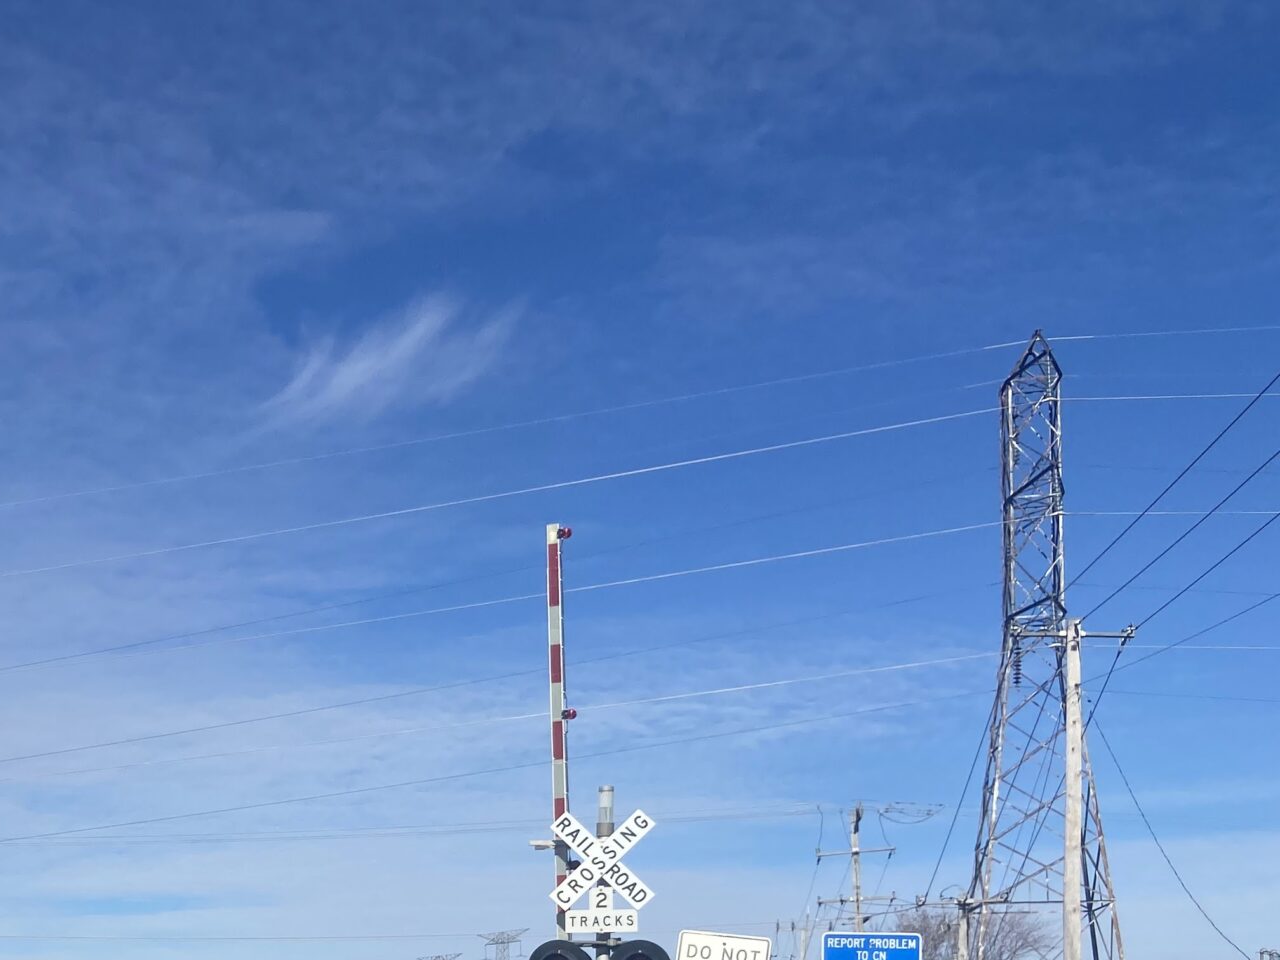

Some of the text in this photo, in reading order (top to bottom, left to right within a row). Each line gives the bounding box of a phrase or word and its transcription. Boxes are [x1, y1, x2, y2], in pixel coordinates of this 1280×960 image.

[556, 815, 649, 904] CROSSING
[595, 892, 608, 908] 2
[569, 915, 634, 927] TRACKS
[827, 937, 916, 949] REPORT PROBLEM
[686, 944, 712, 960] DO
[857, 951, 887, 960] TO CN
